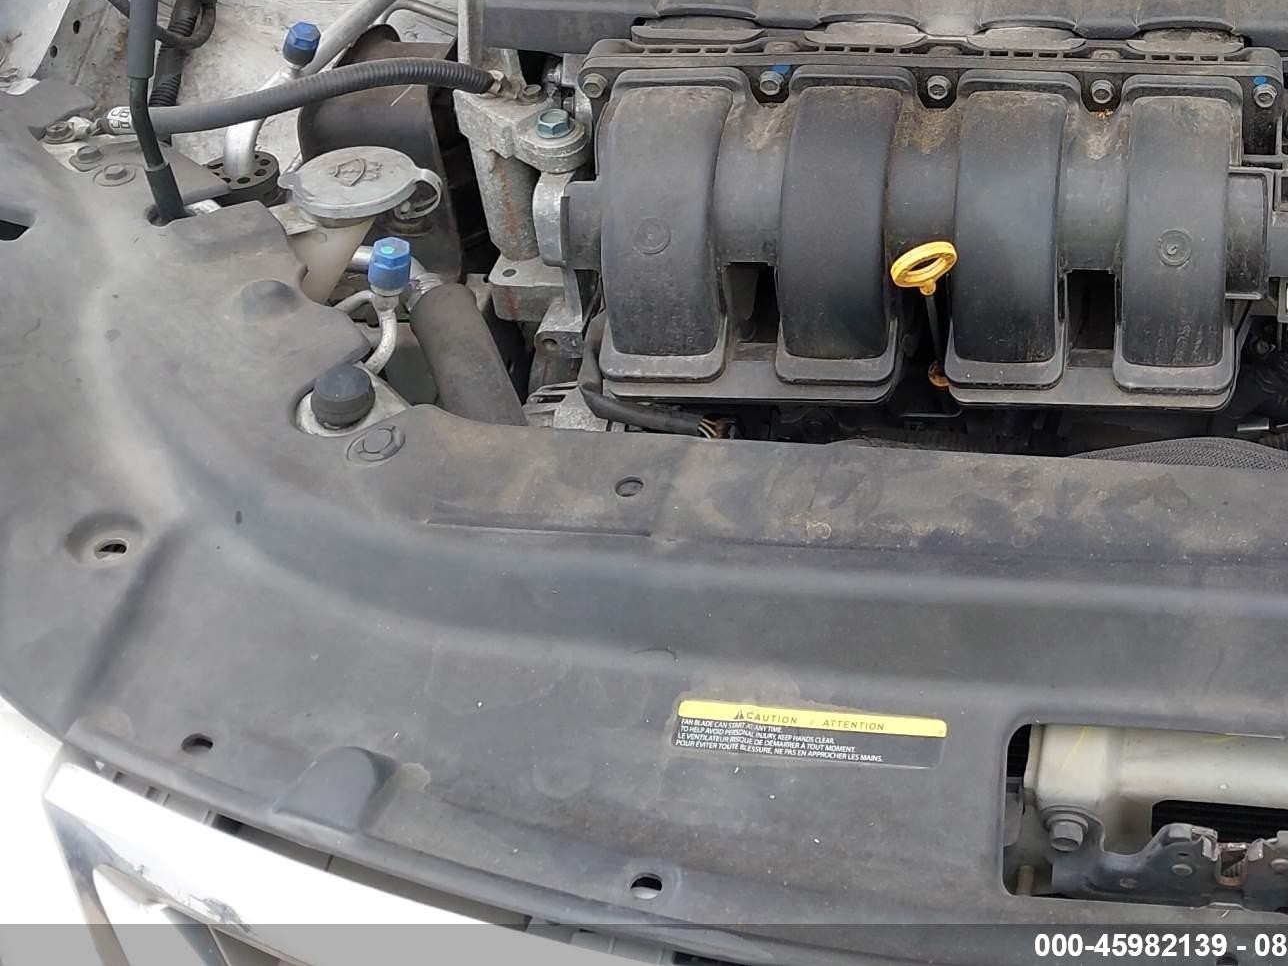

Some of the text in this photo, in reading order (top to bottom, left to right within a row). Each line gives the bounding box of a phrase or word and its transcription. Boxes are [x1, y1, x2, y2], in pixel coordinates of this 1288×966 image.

[747, 712, 798, 724] CAUTION
[822, 719, 885, 731] ATTENTION
[686, 733, 729, 743] VENTILATEUR
[730, 737, 754, 745] RISQUE
[807, 743, 824, 751] TOUT
[705, 728, 725, 736] AVOID
[725, 729, 754, 737] PERSONAL
[793, 734, 814, 742] HANDS
[695, 739, 718, 749] ÉVITER
[774, 747, 784, 755] NE
[784, 748, 797, 756] PAS
[807, 750, 847, 760] APPROCHER
[848, 753, 859, 761] LES
[860, 754, 883, 762] MAINS.
